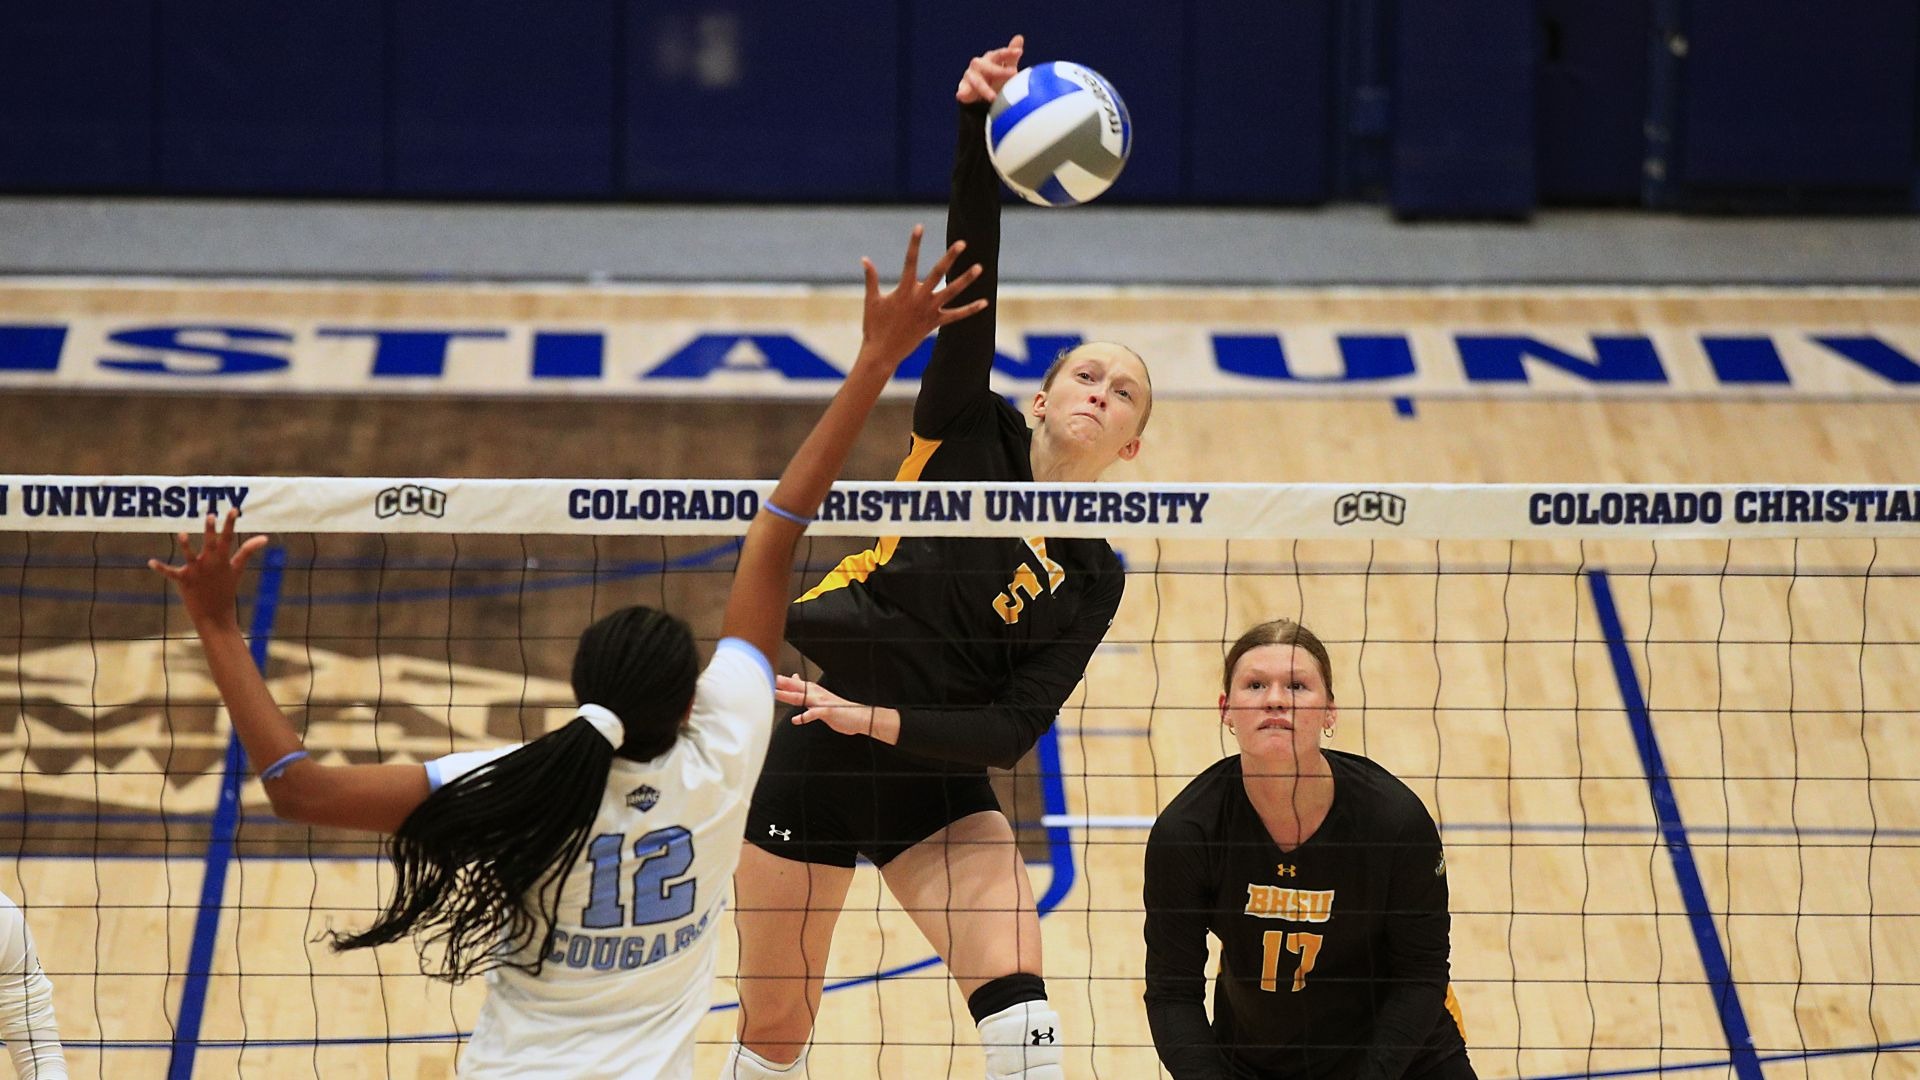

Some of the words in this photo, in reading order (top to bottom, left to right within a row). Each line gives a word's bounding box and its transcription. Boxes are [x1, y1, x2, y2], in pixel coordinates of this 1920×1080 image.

[1073, 70, 1121, 135] molte
[22, 484, 249, 518] UNIVERSITY
[374, 484, 446, 520] CCU
[568, 488, 760, 521] COLORADO
[814, 489, 973, 522] RISTIAN
[984, 491, 1209, 524] UNIVERSITY
[1334, 490, 1406, 525] CCU
[1529, 492, 1723, 525] COLORADO
[1734, 490, 1920, 523] CHRISTIA
[992, 562, 1043, 624] 5
[581, 825, 696, 929] 12
[1244, 883, 1335, 923] BHSU
[1260, 930, 1323, 992] 17
